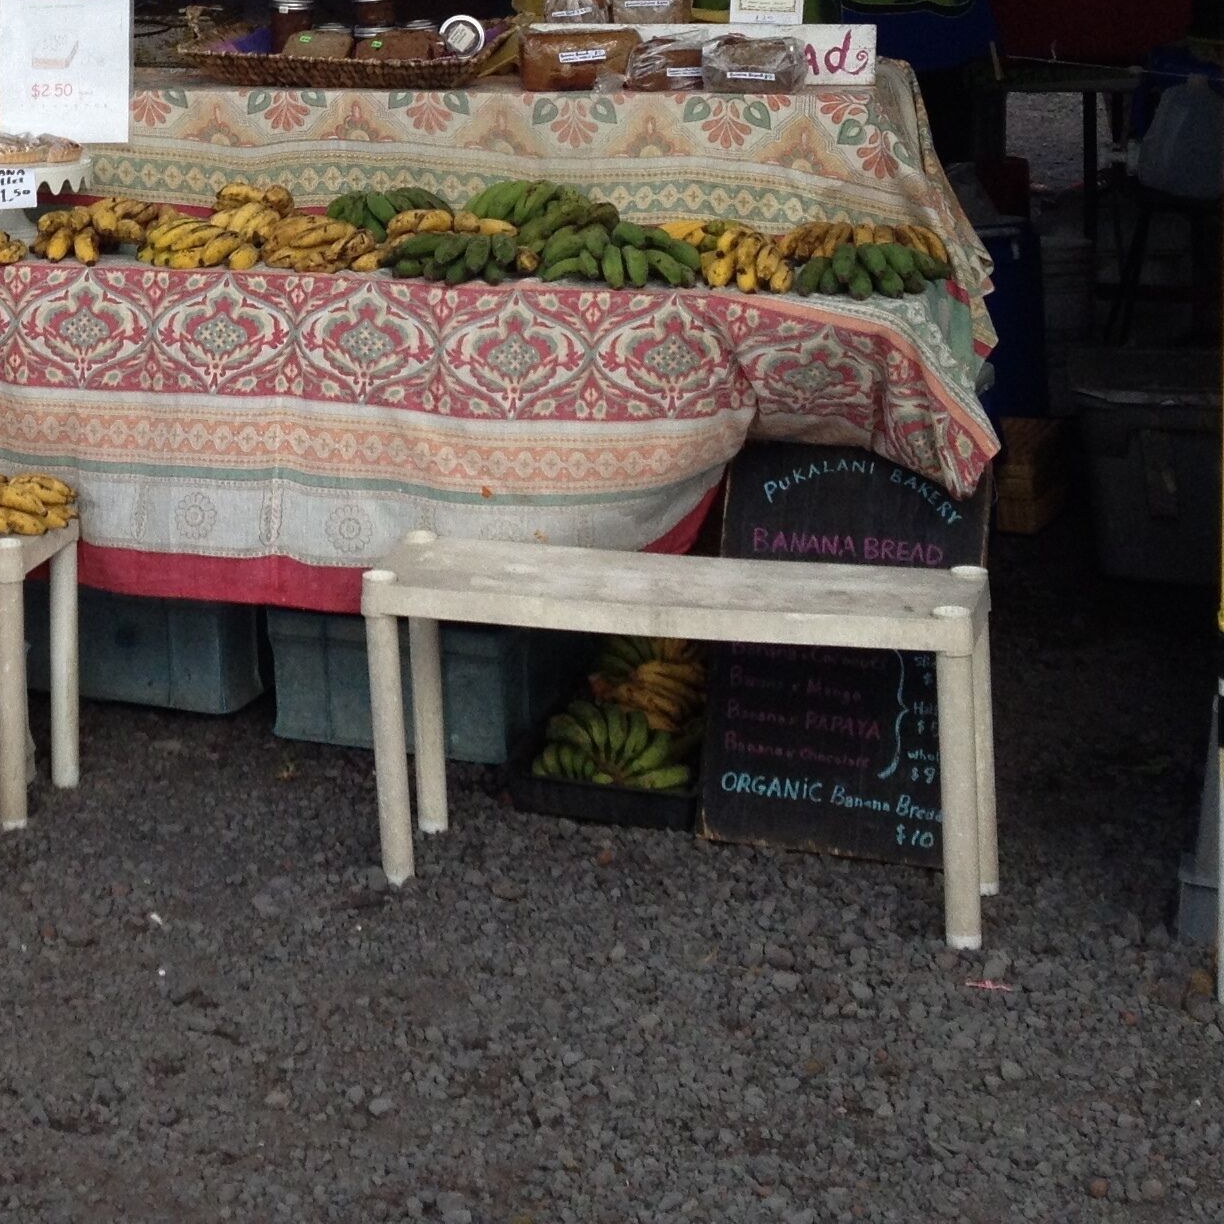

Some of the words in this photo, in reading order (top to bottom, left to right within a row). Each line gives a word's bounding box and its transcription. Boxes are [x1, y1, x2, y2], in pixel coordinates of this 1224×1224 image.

[763, 458, 875, 504] PUKALANI
[890, 468, 963, 526] BAKERY
[752, 527, 856, 557] BANANA
[863, 536, 944, 565] BREAD
[804, 710, 881, 741] PAPAYA
[829, 784, 891, 813] Banana
[896, 824, 935, 848] $10
